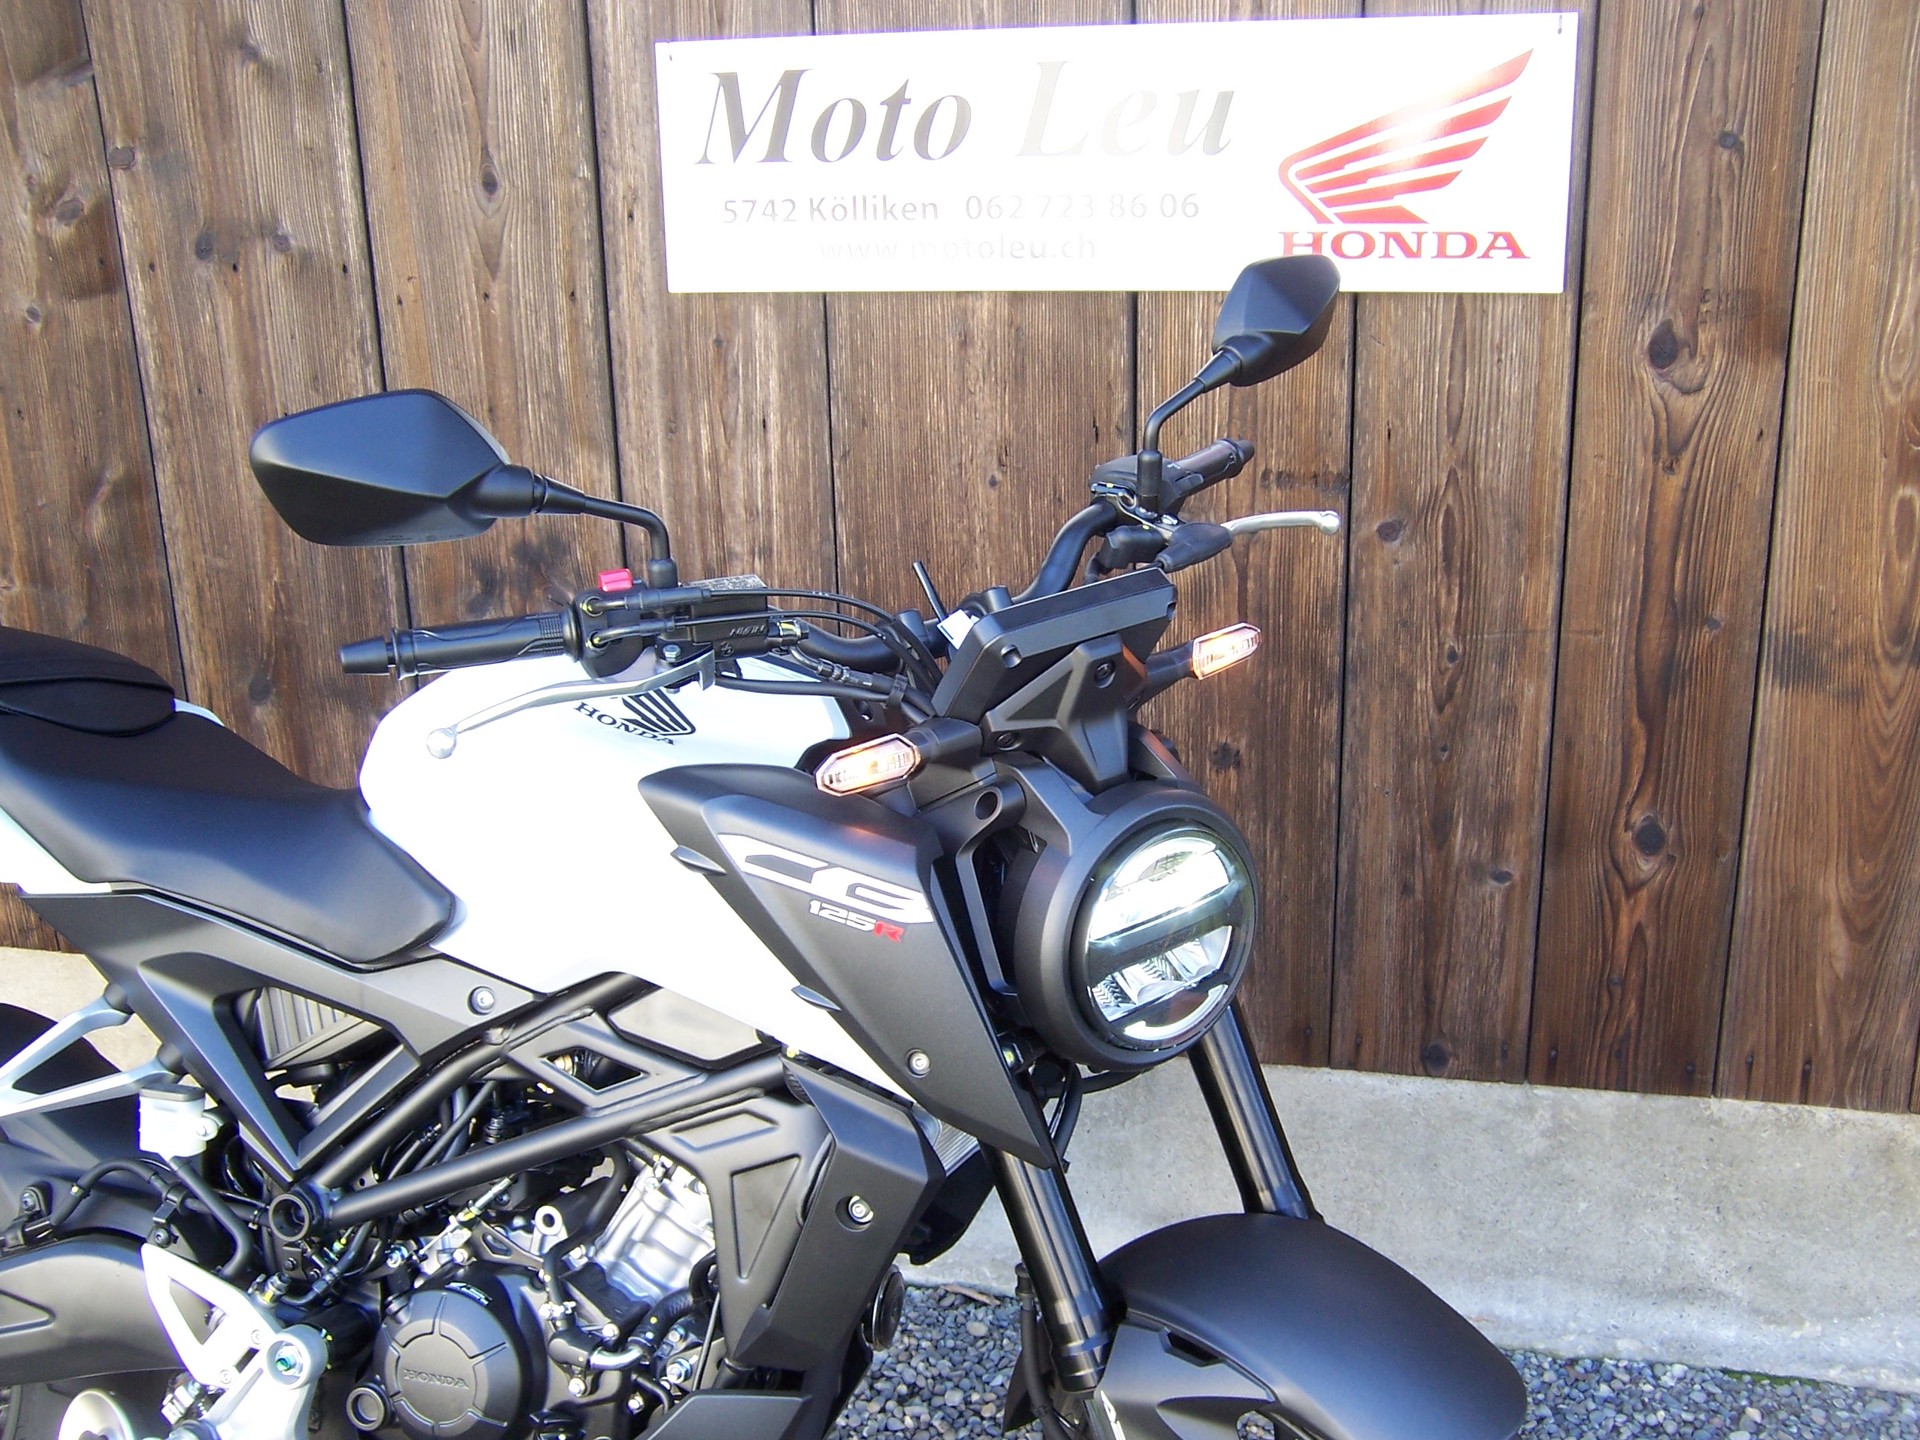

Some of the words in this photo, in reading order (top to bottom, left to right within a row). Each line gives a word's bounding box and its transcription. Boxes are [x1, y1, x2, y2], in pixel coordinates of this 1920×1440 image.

[693, 68, 972, 165] Moto
[1014, 60, 1236, 157] Leu
[723, 199, 798, 224] 5742
[809, 195, 939, 222] Kölliken
[965, 195, 1025, 220] 062
[1039, 194, 1096, 219] 723
[1109, 193, 1148, 218] 86
[1159, 193, 1200, 218] 06
[817, 233, 1097, 260] wwwmotoleu.ch
[1278, 230, 1531, 260] HONDA
[573, 701, 676, 746] HONDA
[808, 899, 905, 943] 125R
[403, 1368, 470, 1389] HONDA
